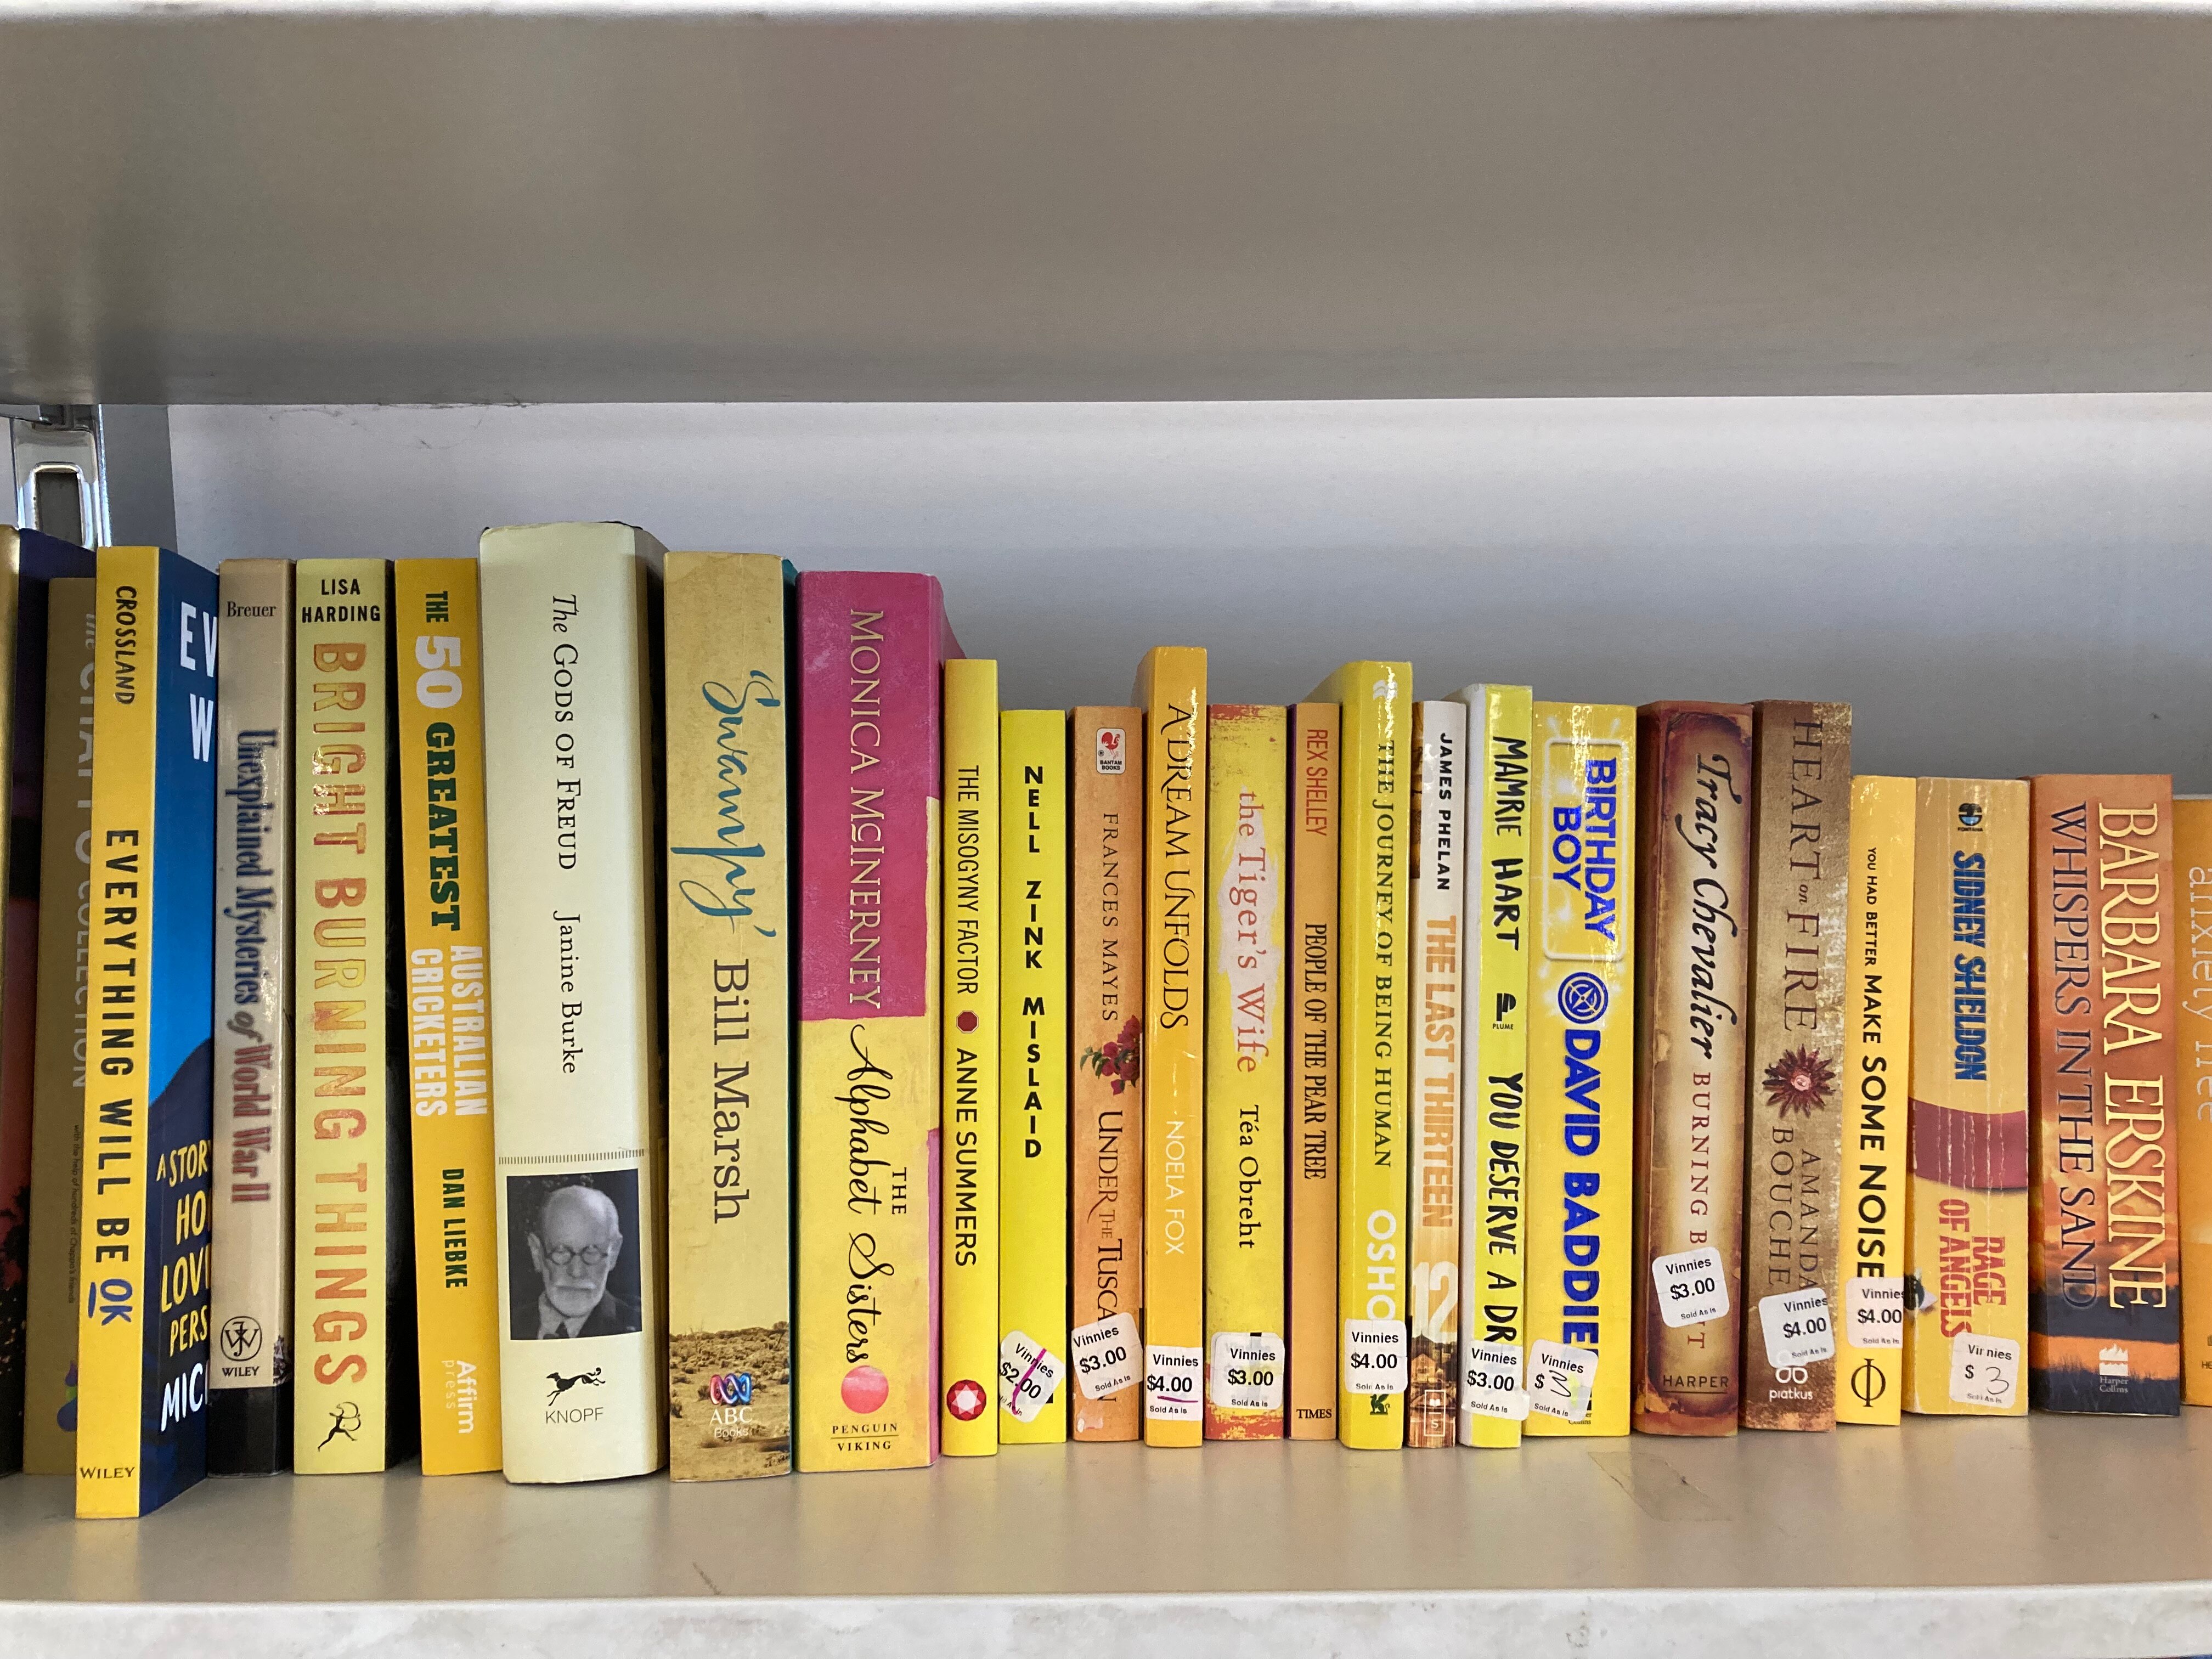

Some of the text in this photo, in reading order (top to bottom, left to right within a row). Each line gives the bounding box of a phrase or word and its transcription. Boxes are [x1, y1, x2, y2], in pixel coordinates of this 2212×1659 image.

[227, 601, 276, 618] Breuer
[301, 605, 381, 623] HARDING
[321, 578, 360, 595] LISA
[115, 585, 137, 705] CROSSLAND
[850, 610, 884, 775] MONICA
[415, 590, 463, 932] THE 50 GREATEST
[551, 593, 583, 871] The GODS OF FREUD
[1306, 729, 1328, 837] REX SHELLEY
[225, 729, 277, 880] Unexplained
[1437, 732, 1452, 890] JAMES PHELAN
[1491, 736, 1529, 951] MAMRIE HART
[1552, 806, 1583, 891] BOY
[1584, 757, 1618, 942] BIRTHDAY
[1674, 752, 1743, 870] Tracy
[957, 765, 979, 995] THE MISOGYNY FACTOR
[1024, 765, 1043, 969] NELL ZINK
[1102, 812, 1120, 1022] FRANCES MAYES
[1160, 703, 1195, 1030] A DREAM UNFOLDS
[1784, 718, 1823, 1031] HEART on FIRE
[224, 885, 273, 1005] Mysteries
[1229, 791, 1269, 1073] the Tiger's Wife
[1372, 740, 1395, 1168] THE JOURNEY OF BEING HUMAN
[1690, 878, 1739, 1060] Chevalier
[1953, 850, 1987, 1081] SIDNEY SHELDON
[227, 1011, 262, 1042] of
[313, 642, 368, 1385] BRIGHT BURNING THINGS
[410, 947, 448, 1118] CRICKETERS
[450, 945, 488, 1116] AUSTRALIAN
[553, 909, 584, 1075] Janine Burke
[95, 830, 139, 1326] EVERYTHING WILL BE OK
[233, 1043, 273, 1118] World
[713, 958, 750, 1224] Bill Marsh
[1022, 996, 1046, 1158] MISLAID
[1305, 923, 1327, 1180] PEOPLE OF THE PEAR TREE
[1488, 1072, 1524, 1130] YOU
[1857, 847, 1887, 1278] YOU HAD BETTER MAKE SOME NOISE
[2051, 800, 2097, 1308] WHISPERS IN THE SAND
[2098, 802, 2168, 1309] BARBARA ERSKINE
[232, 1126, 271, 1178] War
[955, 1047, 978, 1267] ANNE SUMMERS
[1087, 1110, 1124, 1223] UNDER
[1239, 1104, 1262, 1249] Téa Obreht
[1412, 915, 1459, 1344] THE LAST THIRTEEN 12
[1689, 1071, 1711, 1216] BURNING
[442, 1168, 468, 1289] DAN LIEBKE
[834, 1024, 895, 1364] Alphabet Sisters
[891, 1166, 907, 1215] THE
[1098, 1210, 1115, 1239] THE
[1165, 1121, 1185, 1255] NOELA FOX
[1486, 1140, 1521, 1256] DESERVE
[1562, 1029, 1602, 1358] DAVID BADDIE
[1798, 1149, 1821, 1290] AMANDA
[1366, 1209, 1397, 1320] OSHO
[1486, 1271, 1517, 1290] A
[1666, 1258, 1712, 1276] Vinnies
[1670, 1277, 1716, 1301] $3.00
[1938, 1199, 1973, 1338] OF ANGELS
[1972, 1236, 2007, 1306] RAGE
[222, 1366, 259, 1377] WILEY
[441, 1359, 456, 1410] press
[1074, 1326, 1119, 1347] Vinnies
[1079, 1346, 1126, 1374] $3.00
[1147, 1374, 1193, 1392] $4.00
[1153, 1354, 1199, 1367] Vinnies
[1228, 1369, 1273, 1386] $3.00
[1230, 1348, 1276, 1361] Vinnies
[1466, 1369, 1514, 1391] $3.00
[1471, 1347, 1517, 1365] Vinnies
[1534, 1373, 1545, 1390] $
[1541, 1353, 1584, 1373] Vinnies
[1663, 1375, 1729, 1387] HARPER
[2100, 1376, 2128, 1386] Harper
[456, 1360, 478, 1434] Affirm
[545, 1407, 604, 1425] KNOPF
[709, 1407, 753, 1425] ABC
[714, 1427, 749, 1438] Books
[832, 1423, 898, 1435] PENGUIN
[837, 1441, 892, 1452] VIKING
[1296, 1408, 1332, 1419] TIMES
[1769, 1388, 1813, 1402] piatkus
[80, 1466, 136, 1480] WILEY
